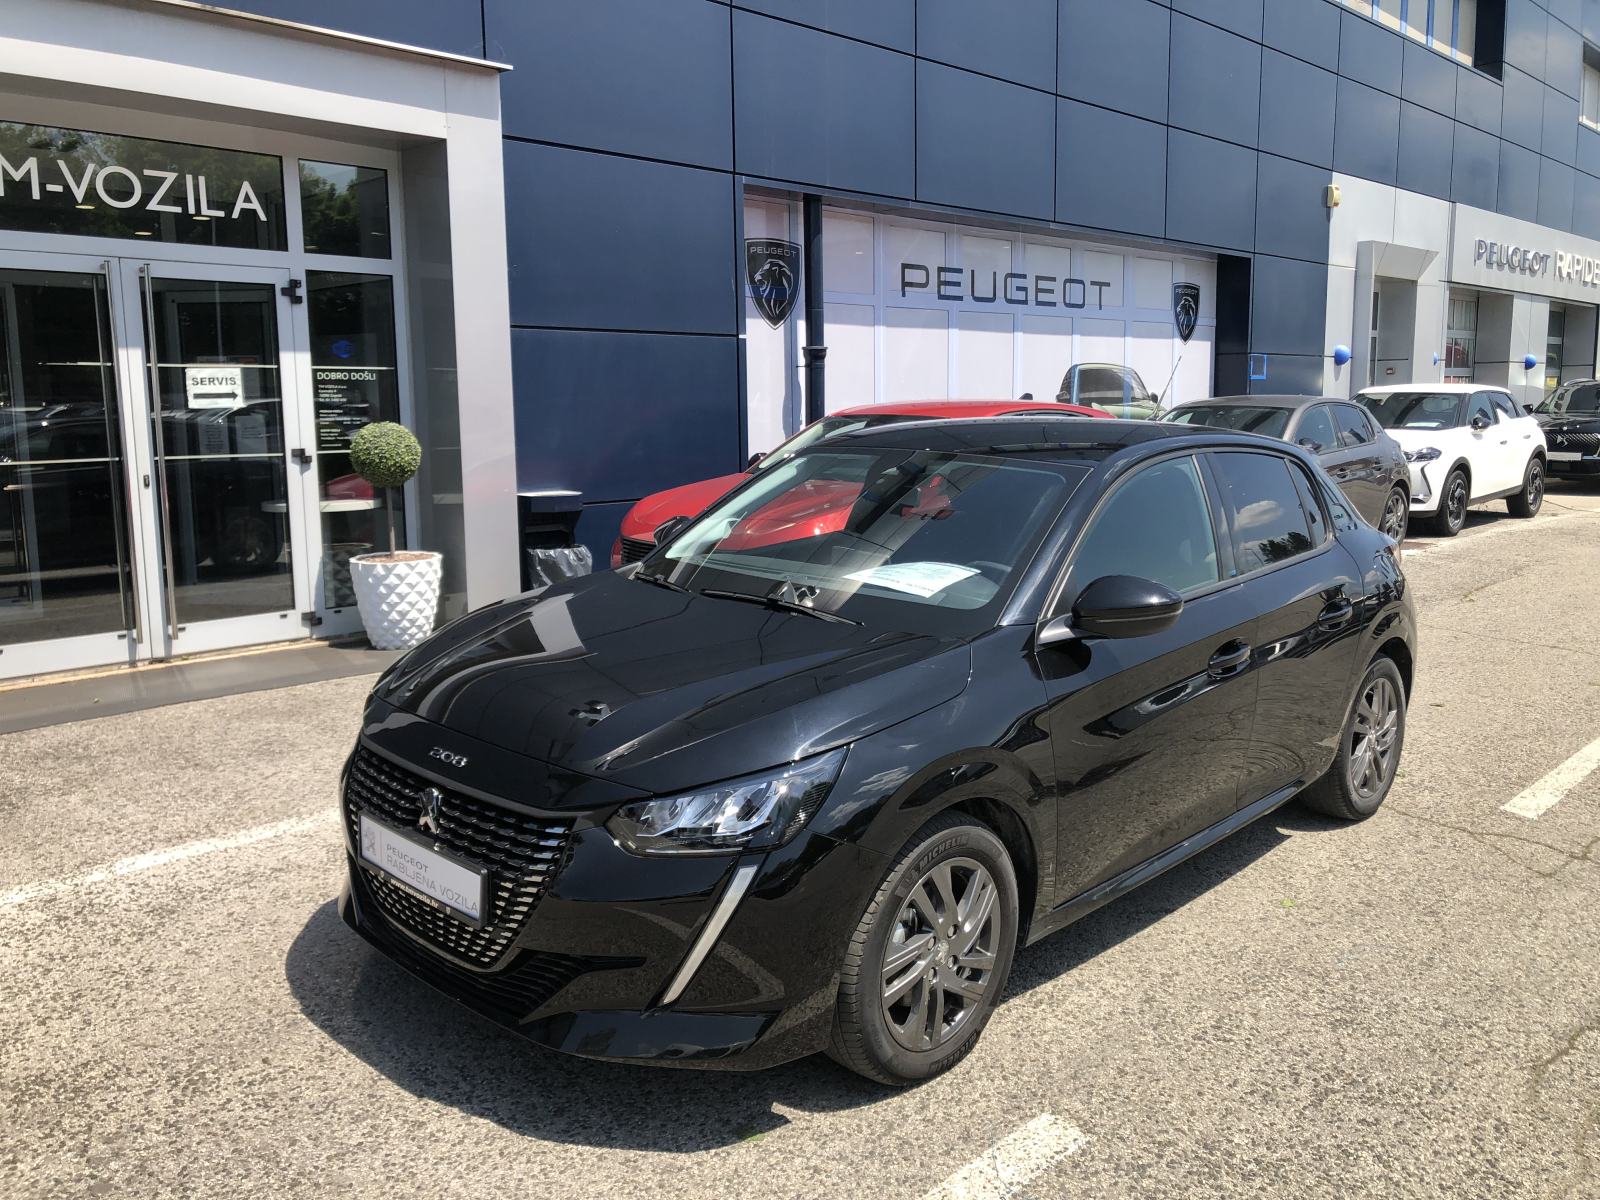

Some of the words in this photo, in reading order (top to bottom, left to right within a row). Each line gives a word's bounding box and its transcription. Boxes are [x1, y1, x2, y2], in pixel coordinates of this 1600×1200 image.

[0, 155, 268, 222] M-VOZILA
[750, 246, 797, 257] PEUGEOT
[1474, 239, 1551, 275] PEUGEOT
[901, 262, 1111, 311] PEUGEOT
[191, 376, 237, 386] SERVIS
[317, 371, 349, 380] DOBRO
[350, 370, 376, 380] DOŠLI
[429, 747, 467, 768] 208
[386, 843, 429, 873] PEUGEOT
[386, 855, 437, 892] RABLJENA
[439, 883, 479, 914] VOZILA
